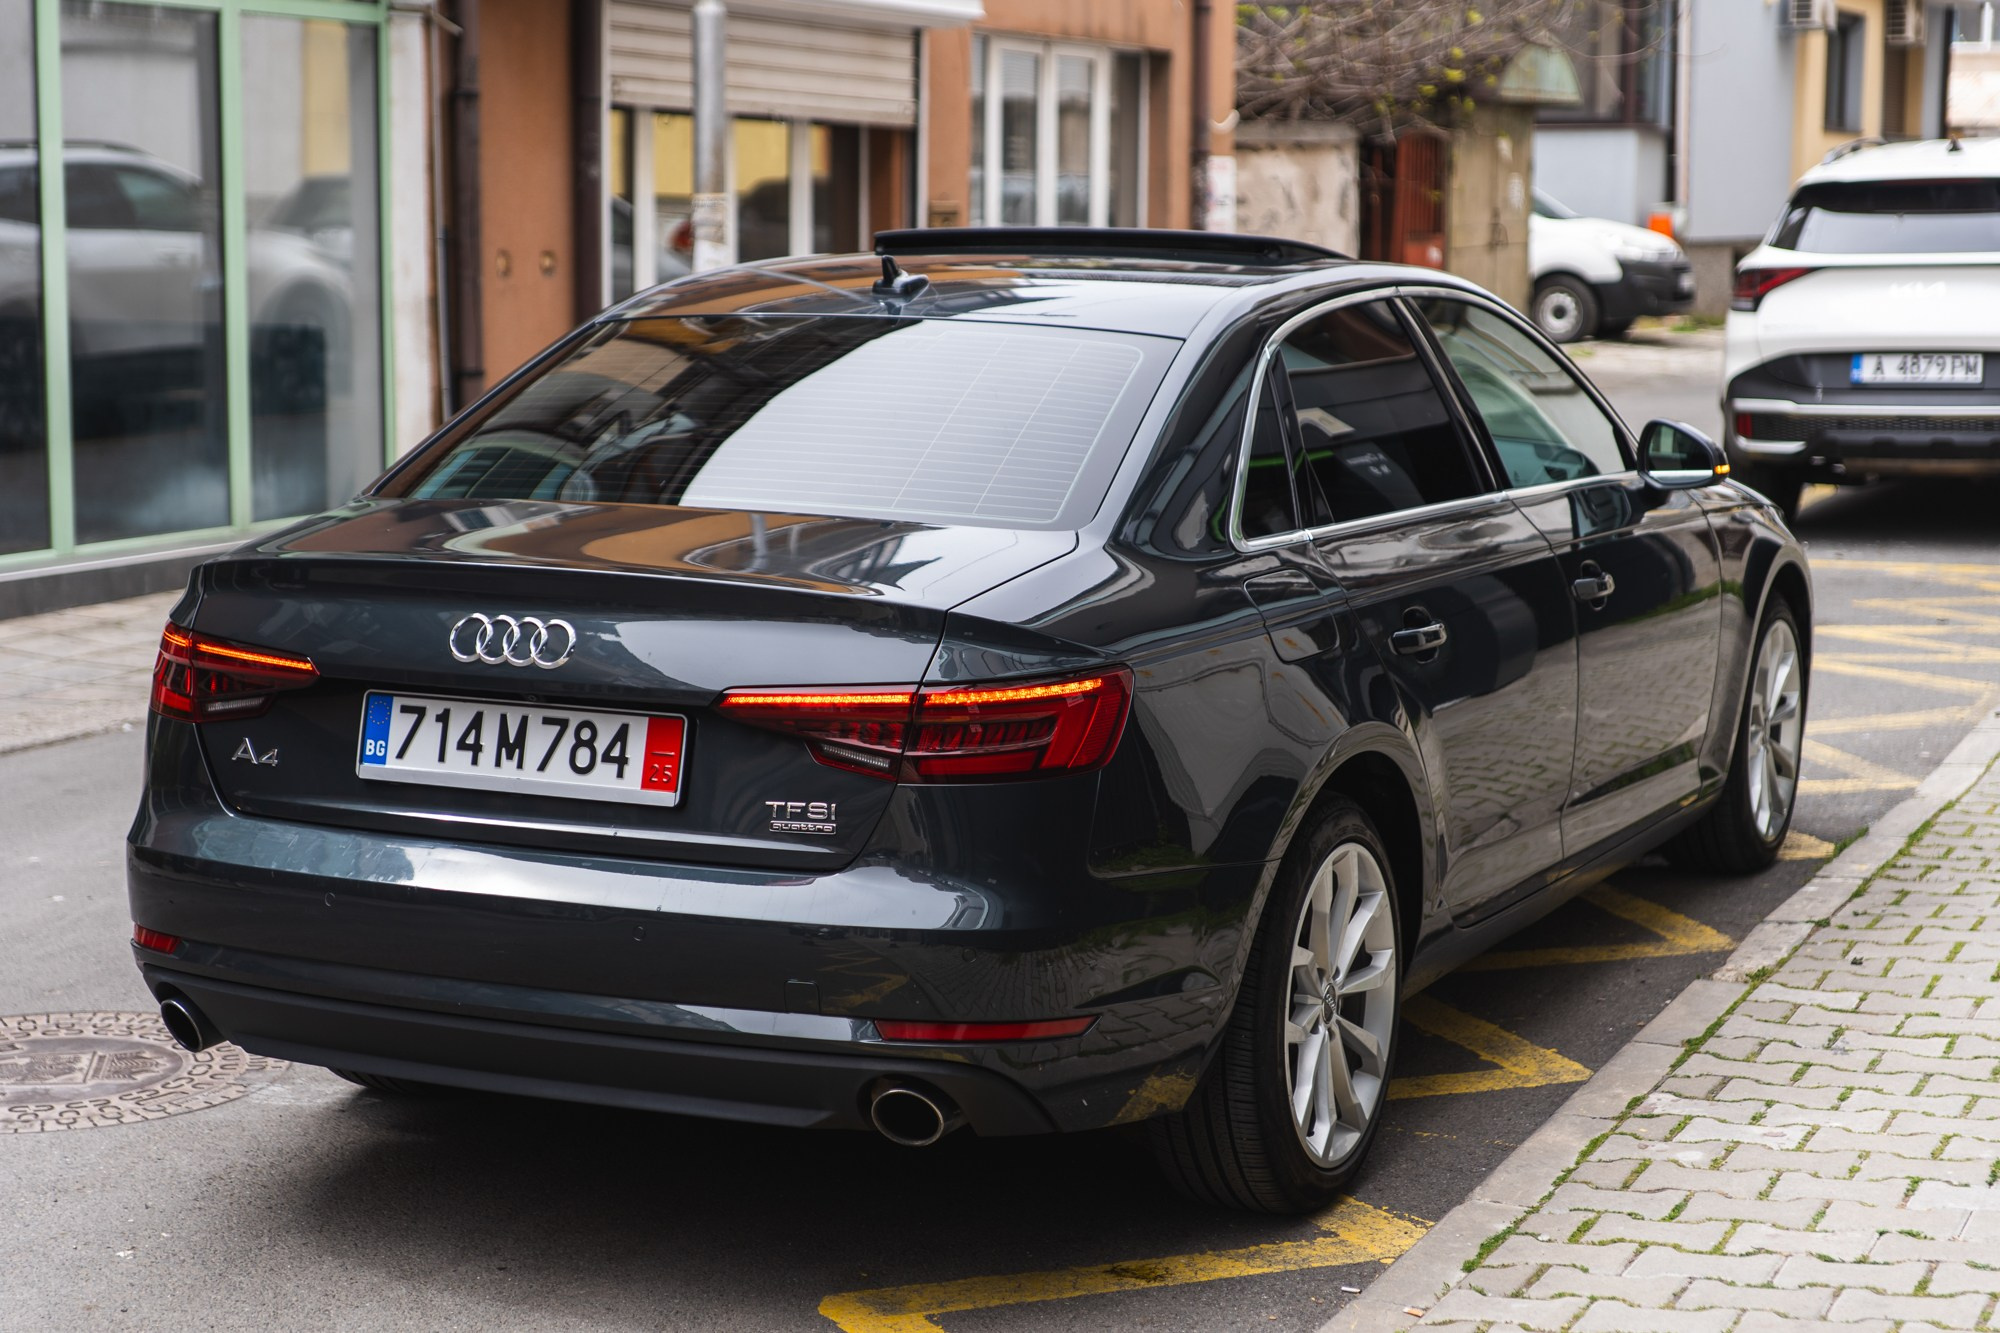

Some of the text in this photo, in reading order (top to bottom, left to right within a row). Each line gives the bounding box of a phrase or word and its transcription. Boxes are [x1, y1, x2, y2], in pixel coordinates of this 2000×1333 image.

[1872, 355, 1885, 375] A
[365, 739, 386, 758] BG
[395, 703, 630, 779] 714M784
[231, 737, 278, 767] A4
[649, 763, 673, 784] 25
[765, 801, 837, 820] TFSI
[772, 823, 833, 833] quattro
